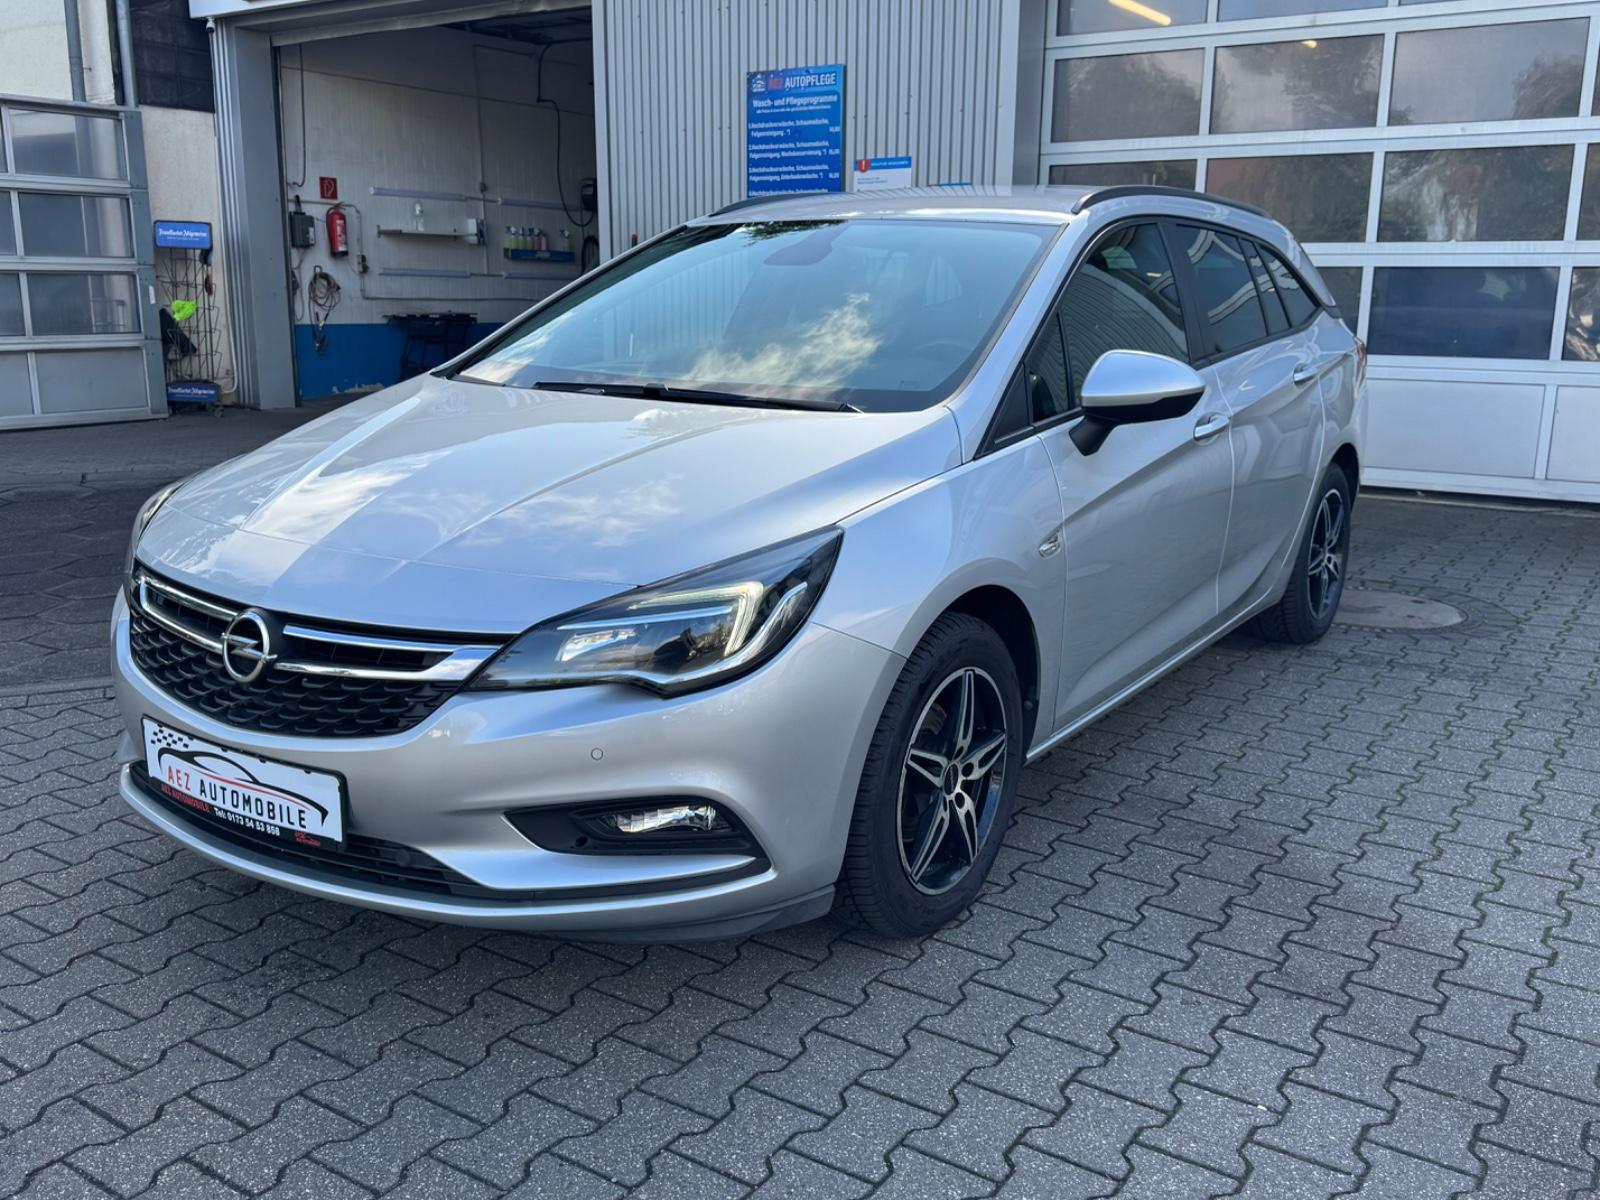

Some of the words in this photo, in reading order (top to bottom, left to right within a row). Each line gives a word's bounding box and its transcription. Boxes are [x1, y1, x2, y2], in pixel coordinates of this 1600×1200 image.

[784, 73, 836, 88] AUTOPFLEGE
[774, 98, 785, 106] und
[786, 94, 838, 106] Pflegeprogramme
[168, 765, 191, 791] AEZ
[200, 779, 307, 829] AUTOMOBILE
[227, 812, 244, 825] 0173
[245, 818, 254, 829] 54
